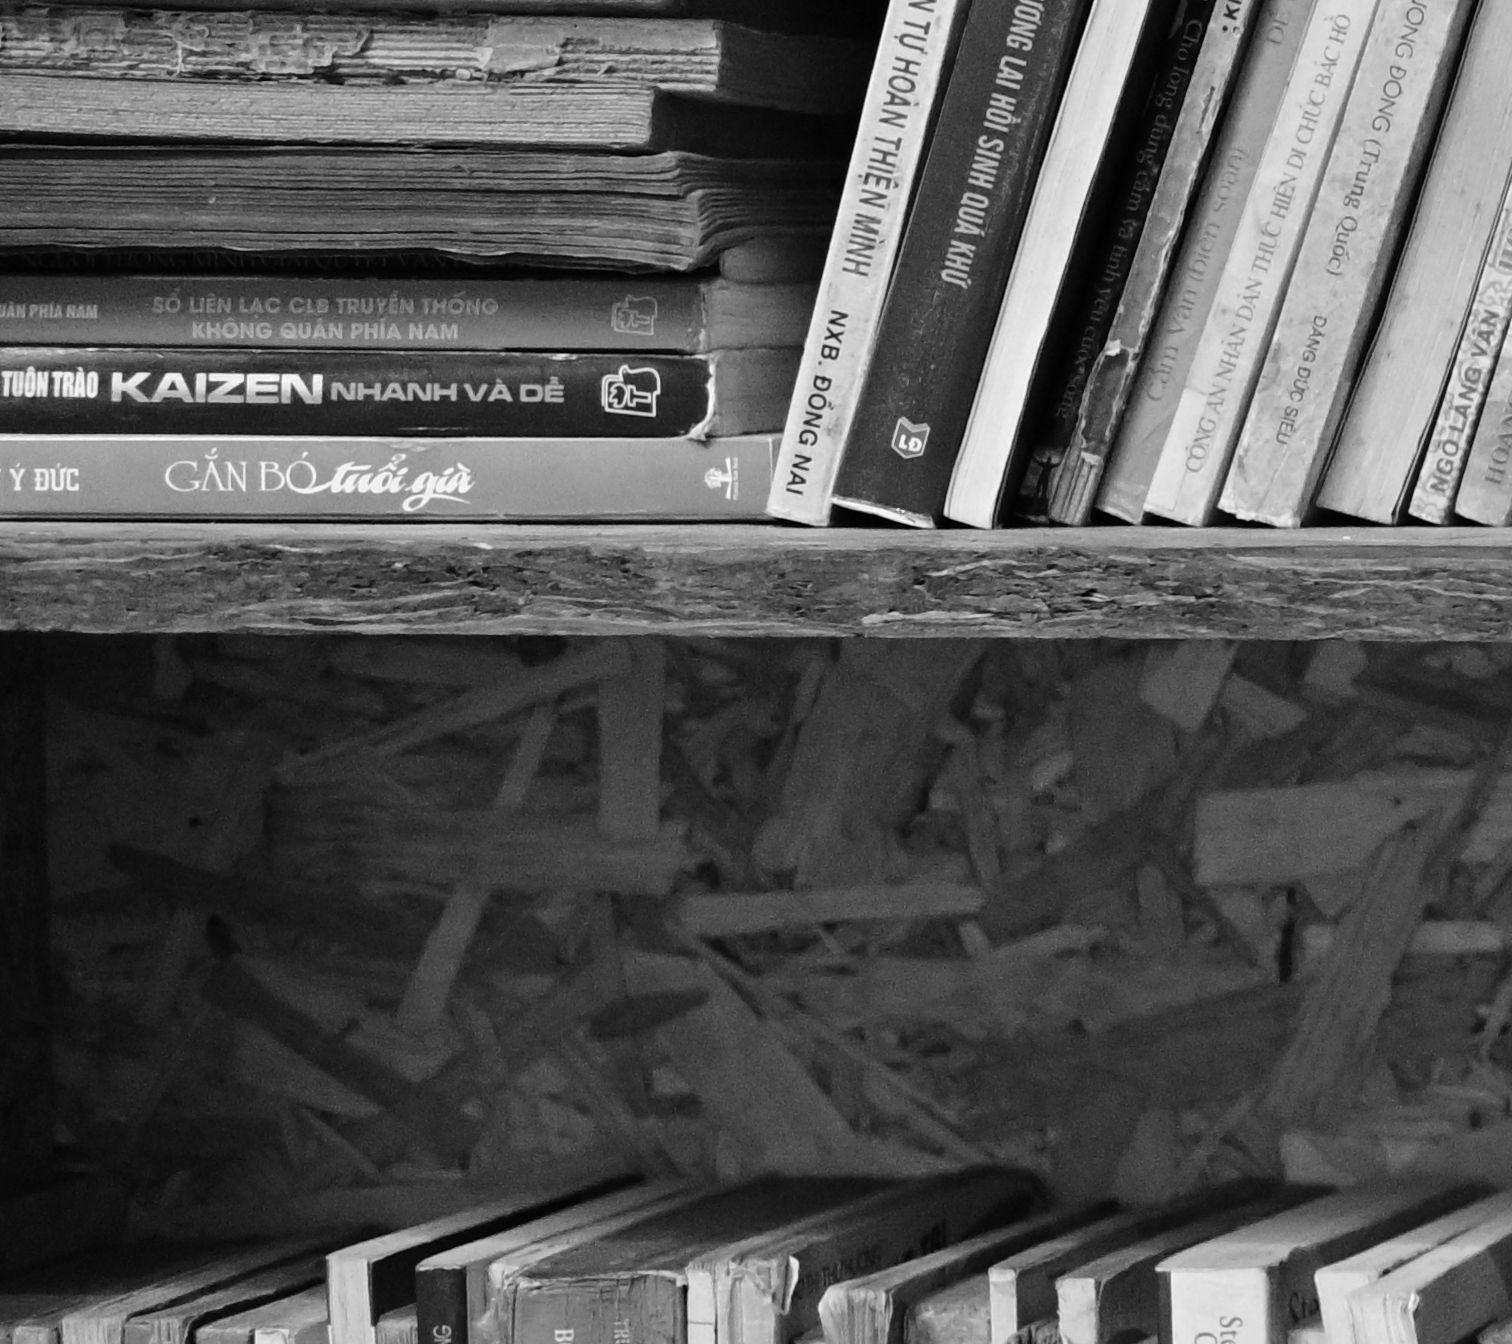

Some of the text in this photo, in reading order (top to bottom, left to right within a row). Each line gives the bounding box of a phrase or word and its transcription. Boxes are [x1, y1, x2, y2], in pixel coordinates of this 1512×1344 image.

[894, 21, 931, 55] TỰ
[878, 56, 921, 128] HOÀN
[995, 56, 1027, 90] LAI
[983, 93, 1019, 132] HỒI
[857, 136, 902, 209] THIỆN
[968, 135, 1004, 189] SINH
[954, 192, 989, 237] QUÁ
[842, 213, 882, 277] MÌNH
[941, 239, 976, 289] KHỨ
[1, 366, 98, 398] TUÔN TRÀO
[111, 372, 564, 404] KAIZEN NHANH VÀ DỄ
[786, 310, 849, 495] NXB. ĐỒNG NAI
[9, 463, 79, 491] Ý ĐỨC
[165, 445, 475, 512] GẮN BÓ tuổi già
